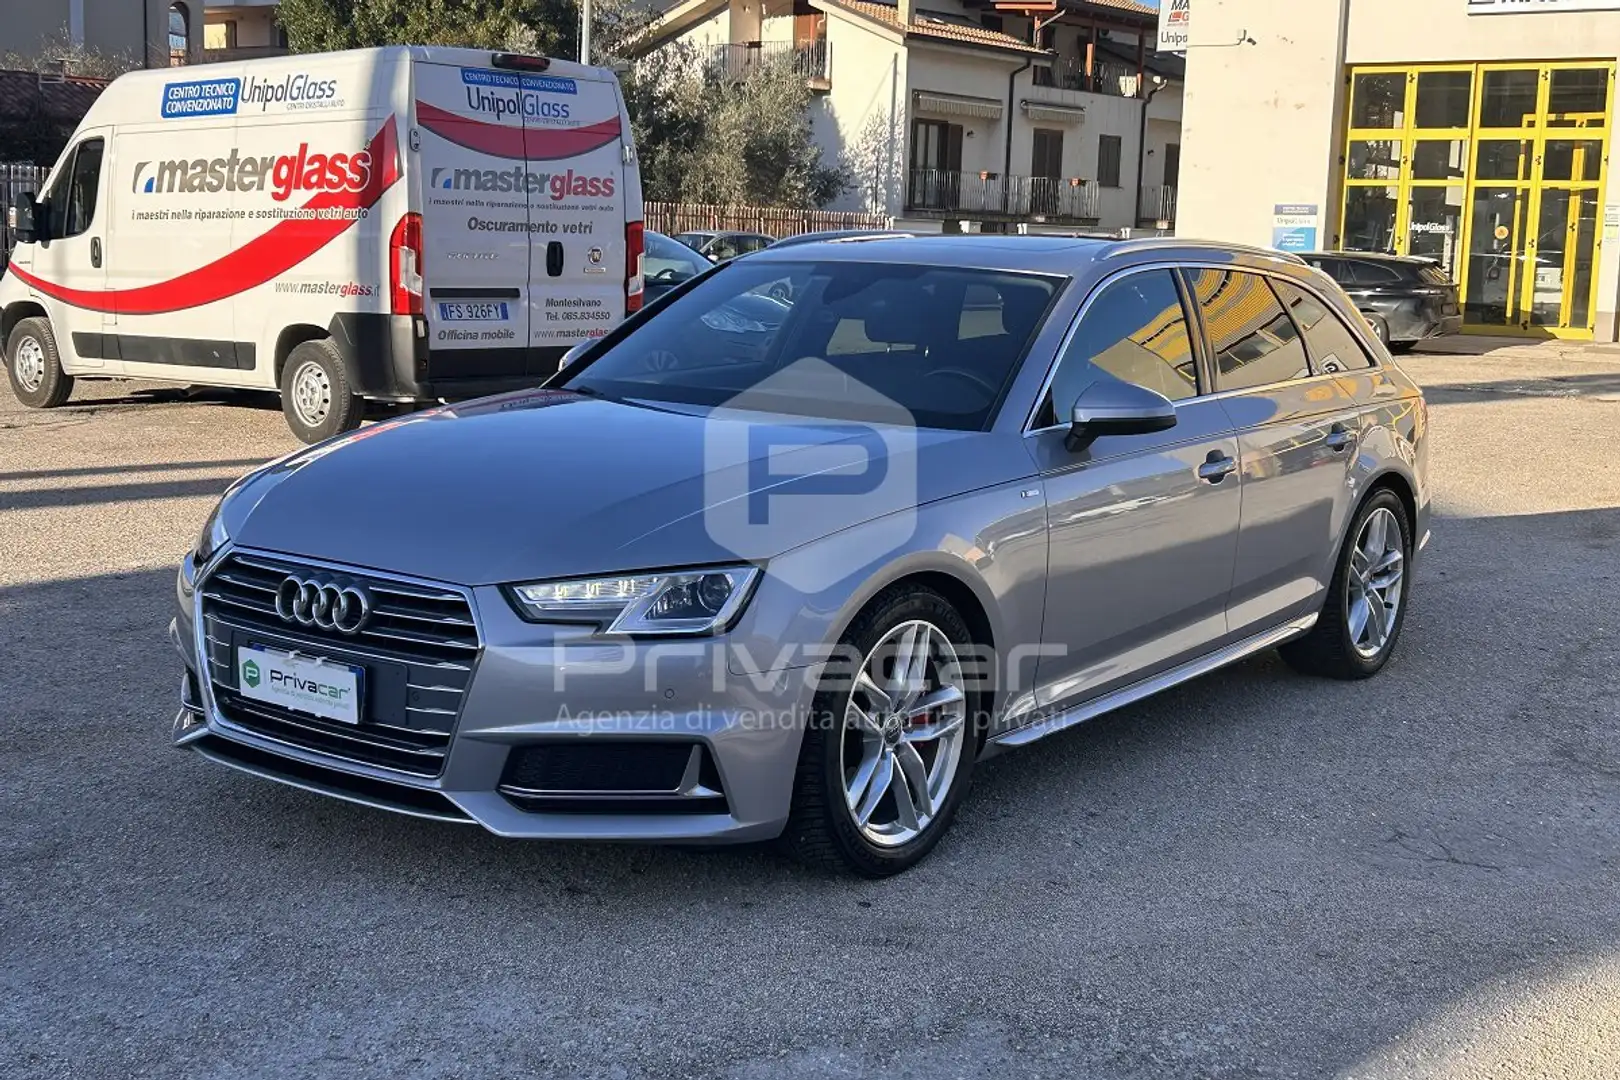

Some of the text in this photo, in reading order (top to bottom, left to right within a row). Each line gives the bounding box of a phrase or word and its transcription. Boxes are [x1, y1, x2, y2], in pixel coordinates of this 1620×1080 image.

[464, 72, 574, 91] CENTRO TECNICO CONVENZIONATO
[168, 82, 235, 99] CENTRO TECNICO
[240, 74, 337, 112] UnipolGlass
[166, 97, 234, 113] CONVENZIONATO
[466, 86, 570, 121] UnipolGlass
[156, 142, 371, 201] masterglass
[453, 166, 615, 201] masterglass
[433, 198, 464, 206] maestri
[136, 208, 169, 220] maestri
[171, 209, 192, 220] nella
[195, 208, 246, 222] riparazione
[248, 210, 254, 219] e
[256, 207, 314, 219] sostituzione
[317, 206, 344, 219] vetri
[344, 207, 369, 219] auto
[467, 216, 593, 235] Oscuramento vetri
[275, 281, 380, 298] www.masterglass.it
[545, 297, 602, 308] Montesilvano
[448, 304, 499, 319] FS 926FY
[545, 311, 560, 321] Tel.
[438, 328, 515, 340] Officina mobile
[270, 669, 348, 700] Privacar
